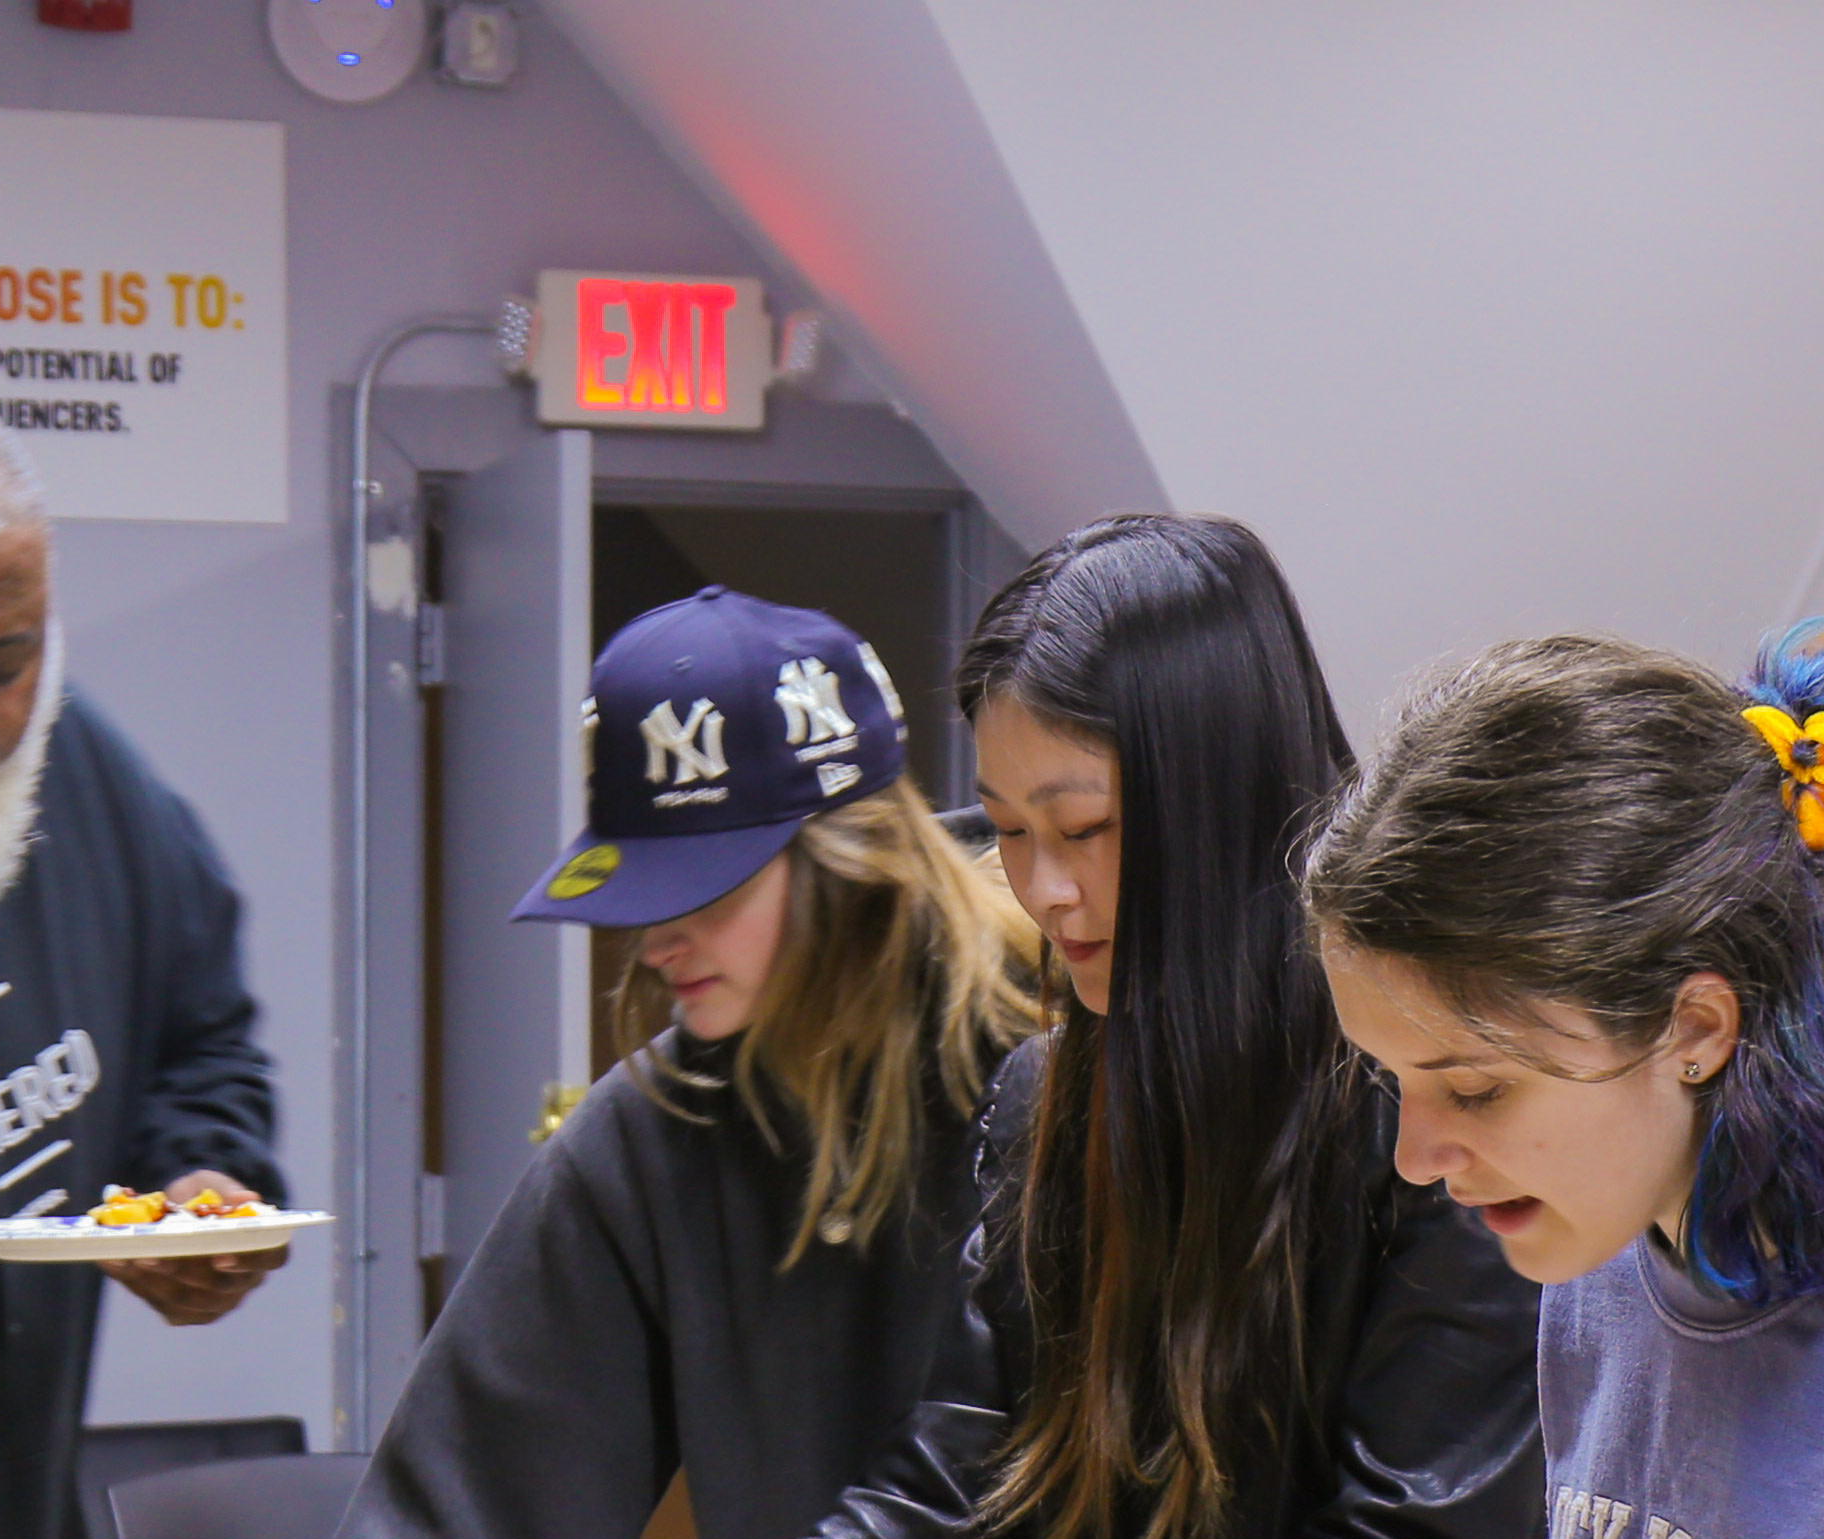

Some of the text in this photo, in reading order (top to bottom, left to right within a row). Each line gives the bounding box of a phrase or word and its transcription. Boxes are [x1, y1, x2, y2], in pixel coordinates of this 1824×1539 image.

[102, 271, 148, 327] IS
[166, 275, 245, 331] TO:
[150, 354, 183, 385] OF
[578, 277, 737, 414] EXIT
[640, 700, 730, 784] NY
[775, 656, 857, 745] NY
